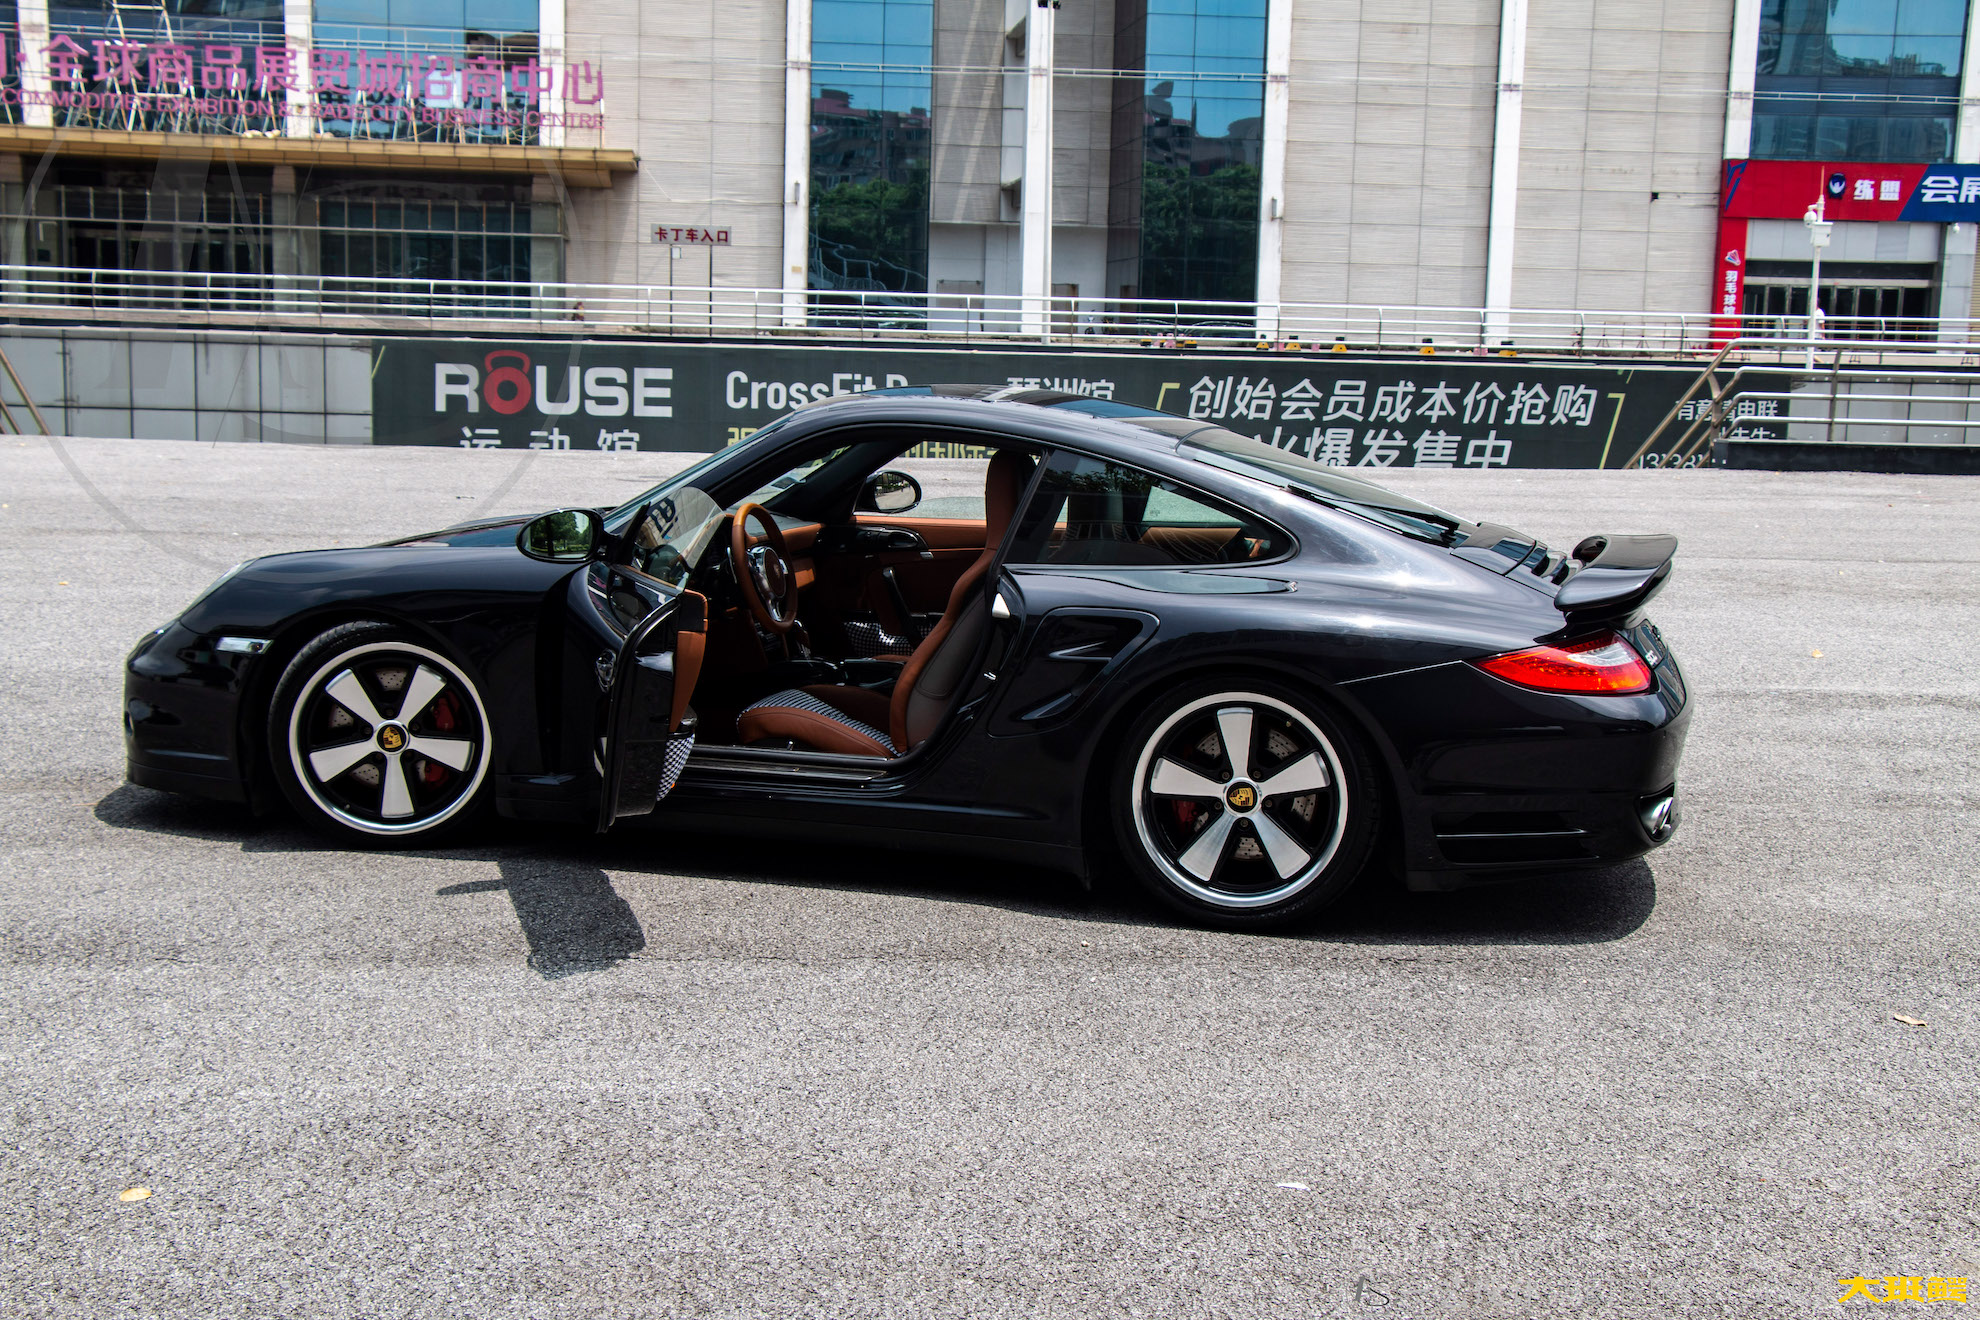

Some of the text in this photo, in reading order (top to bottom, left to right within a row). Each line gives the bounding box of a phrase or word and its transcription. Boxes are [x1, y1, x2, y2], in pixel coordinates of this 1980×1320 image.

[422, 106, 520, 126] BUSINESS
[654, 226, 729, 243] 卡丁车入口
[434, 350, 673, 418] ROUSE
[1188, 375, 1598, 427] 创始会员成本价抢购
